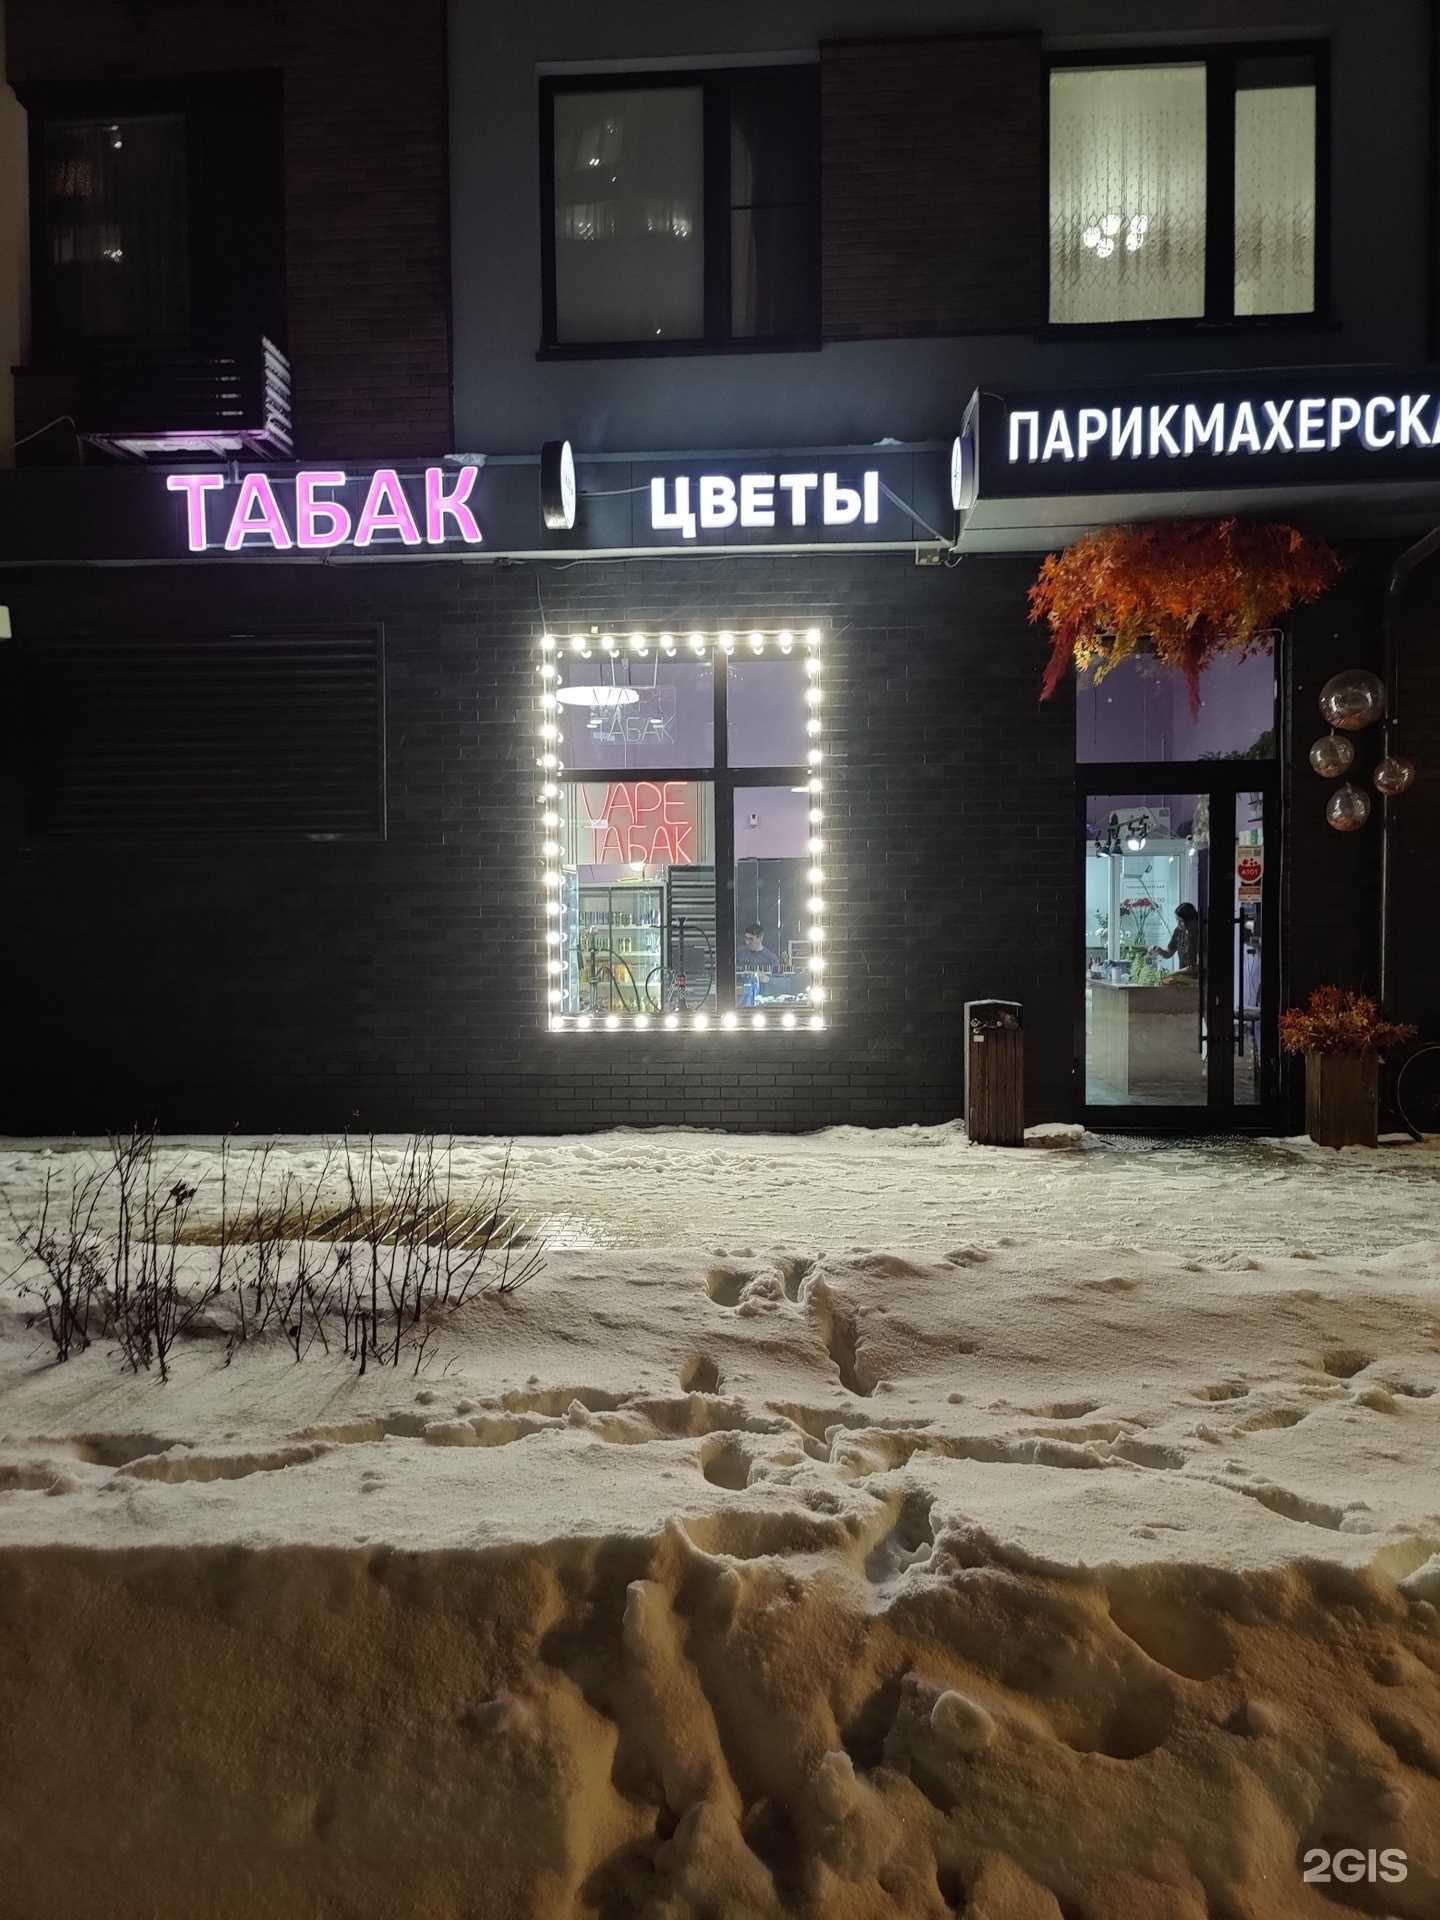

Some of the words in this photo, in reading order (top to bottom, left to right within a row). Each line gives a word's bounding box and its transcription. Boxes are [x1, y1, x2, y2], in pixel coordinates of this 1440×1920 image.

[1008, 395, 1440, 460] ПАРИКМАХЕРСК
[165, 466, 483, 552] ТАБАК
[650, 470, 880, 539] ЦВЕТЫ
[580, 781, 689, 825] VAPE
[584, 825, 693, 865] ТАБАК
